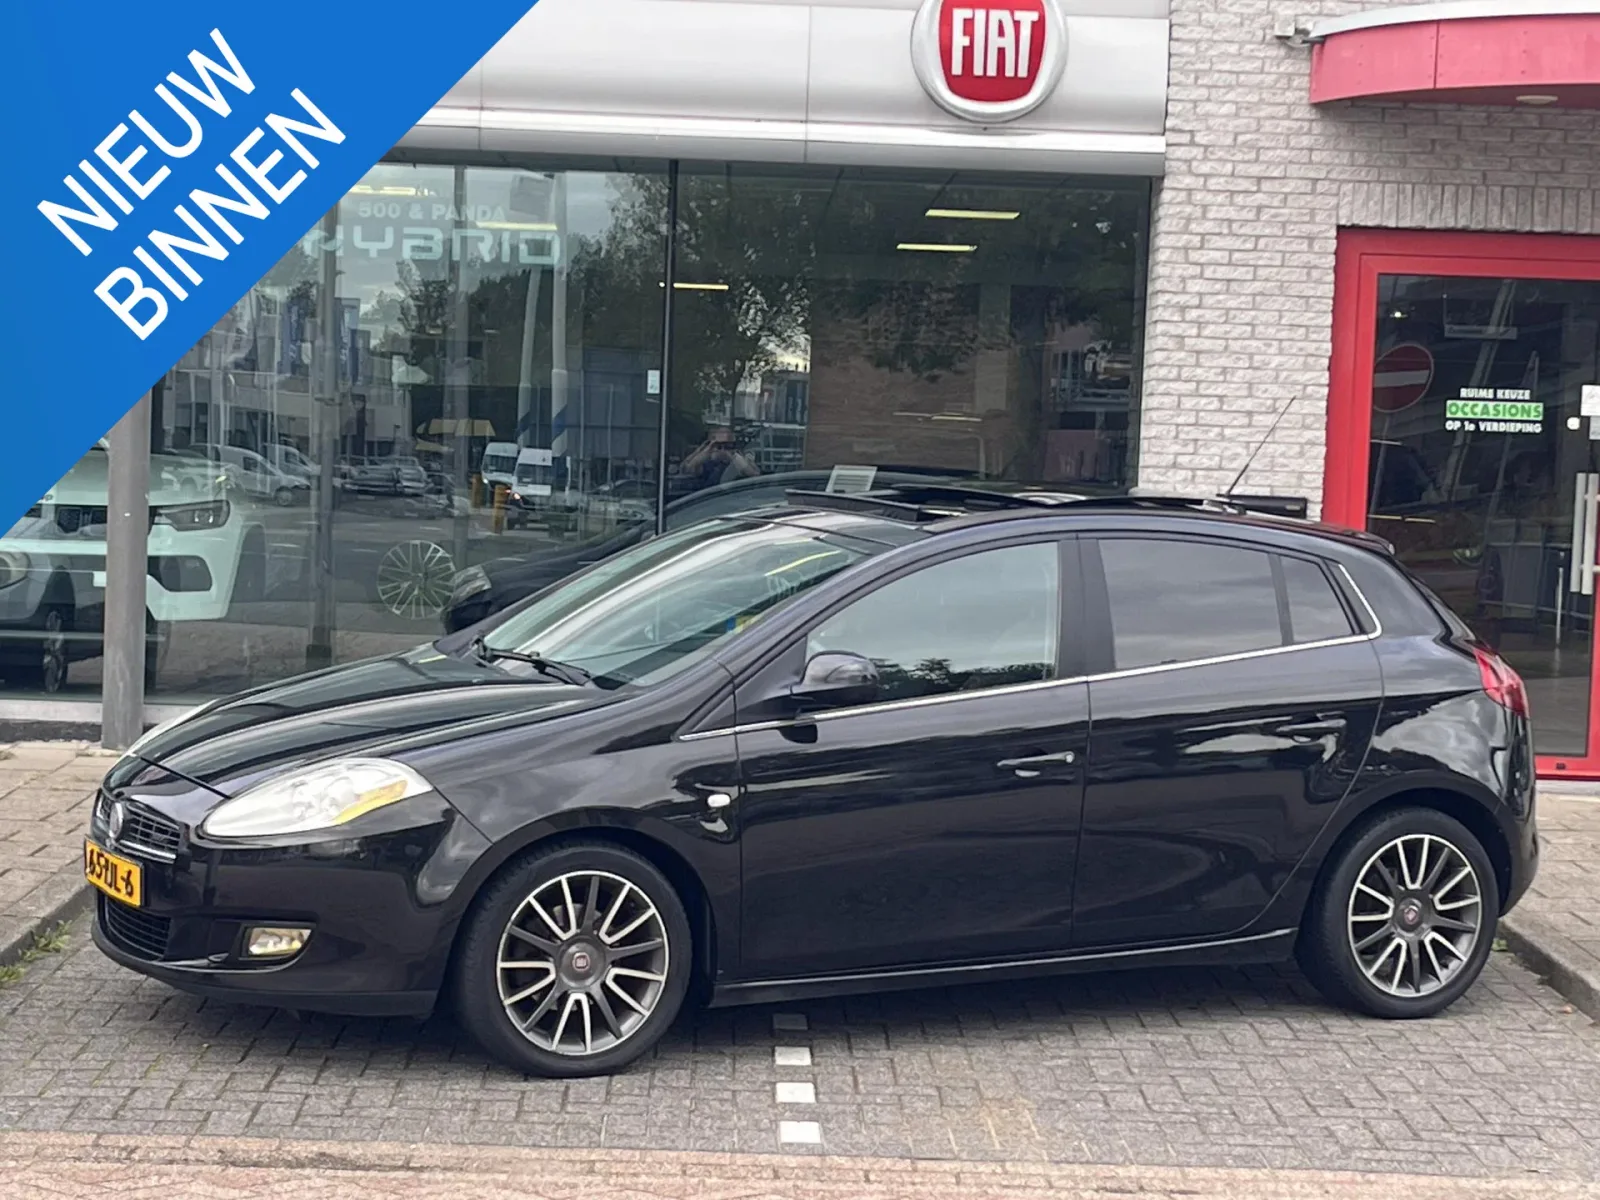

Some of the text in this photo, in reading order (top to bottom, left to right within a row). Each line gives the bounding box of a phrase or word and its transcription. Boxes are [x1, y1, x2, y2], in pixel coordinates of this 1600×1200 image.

[951, 8, 1039, 78] FIAT
[358, 203, 506, 222] 500 & PANDA
[1496, 389, 1531, 400] KEUZE
[1447, 402, 1542, 418] OCCASIONS
[1445, 420, 1462, 431] OP
[1479, 421, 1542, 433] VERDIEPING
